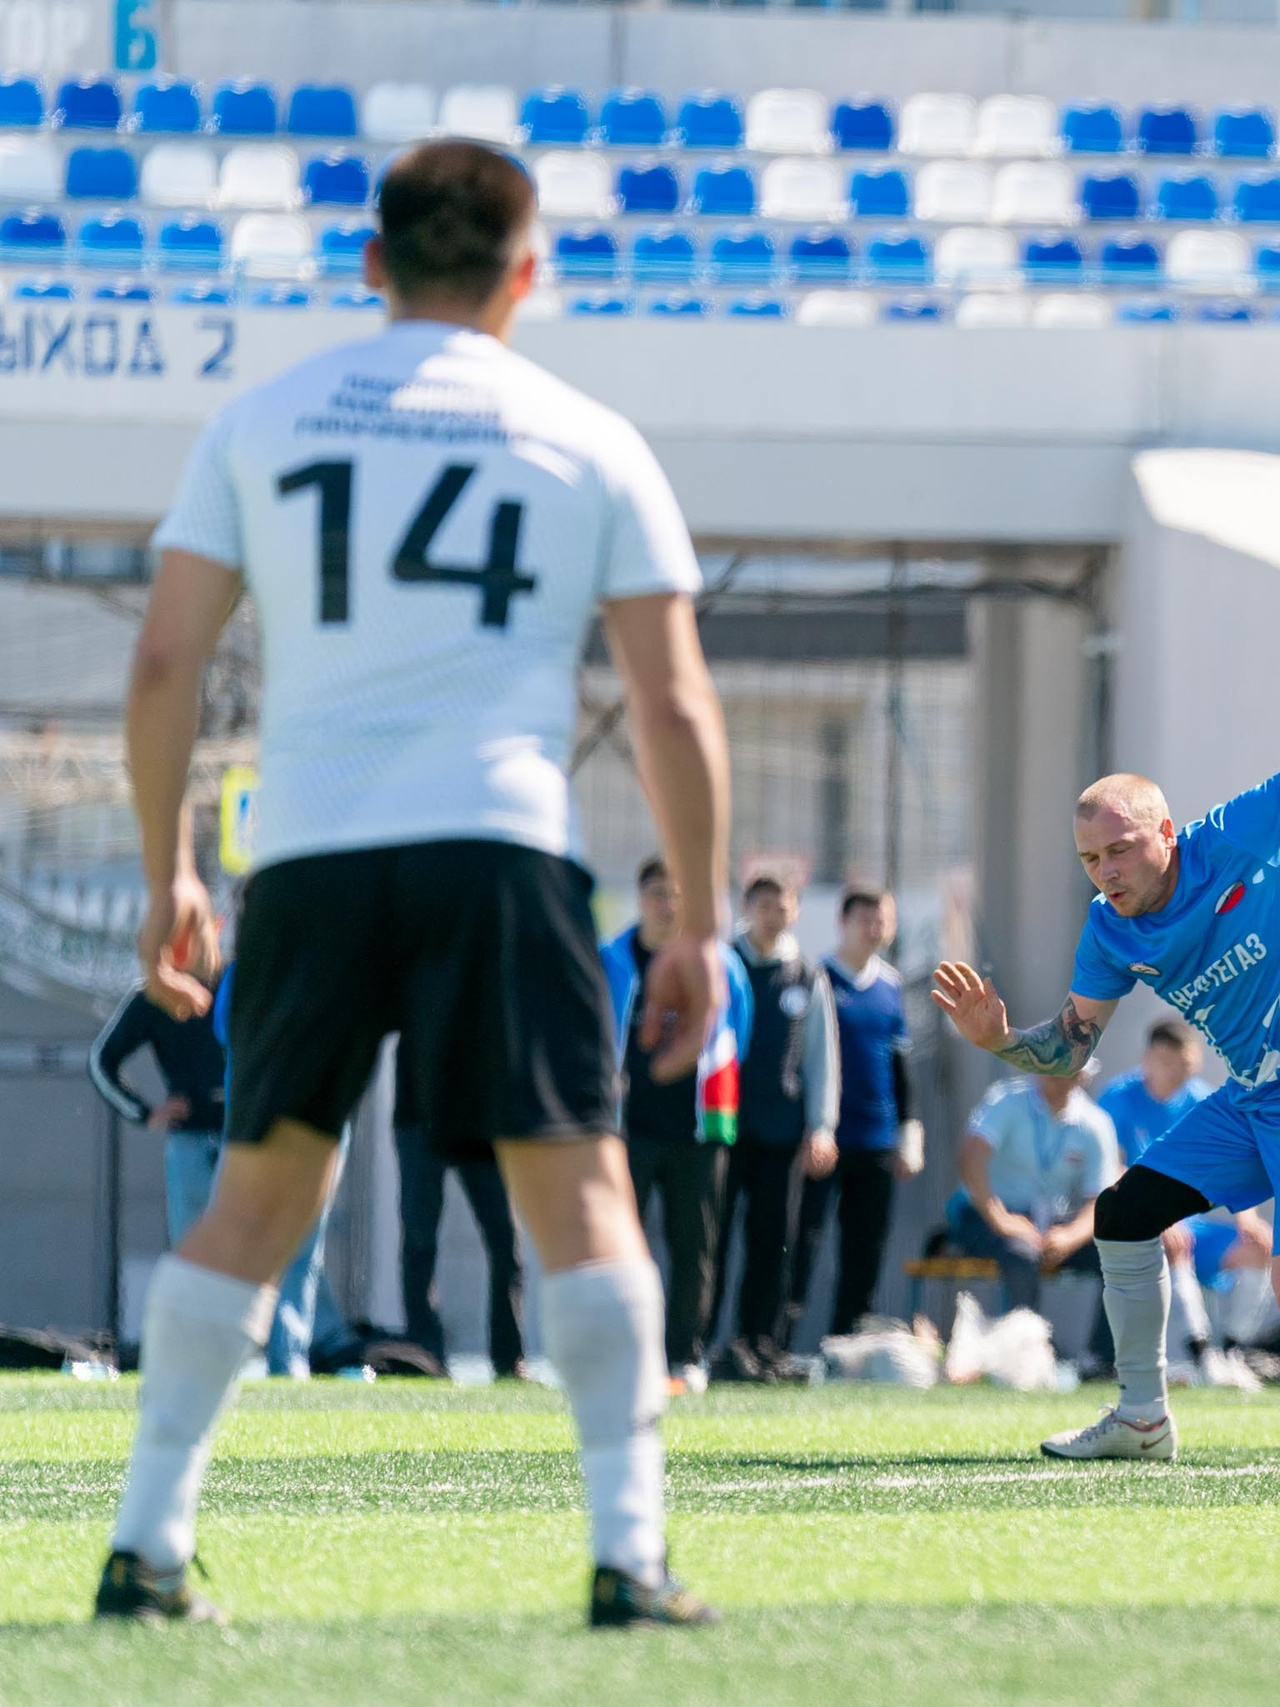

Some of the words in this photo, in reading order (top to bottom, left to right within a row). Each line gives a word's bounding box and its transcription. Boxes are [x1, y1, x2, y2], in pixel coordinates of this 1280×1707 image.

[115, 0, 156, 70] 6
[196, 314, 236, 379] 2
[277, 461, 536, 628] 14
